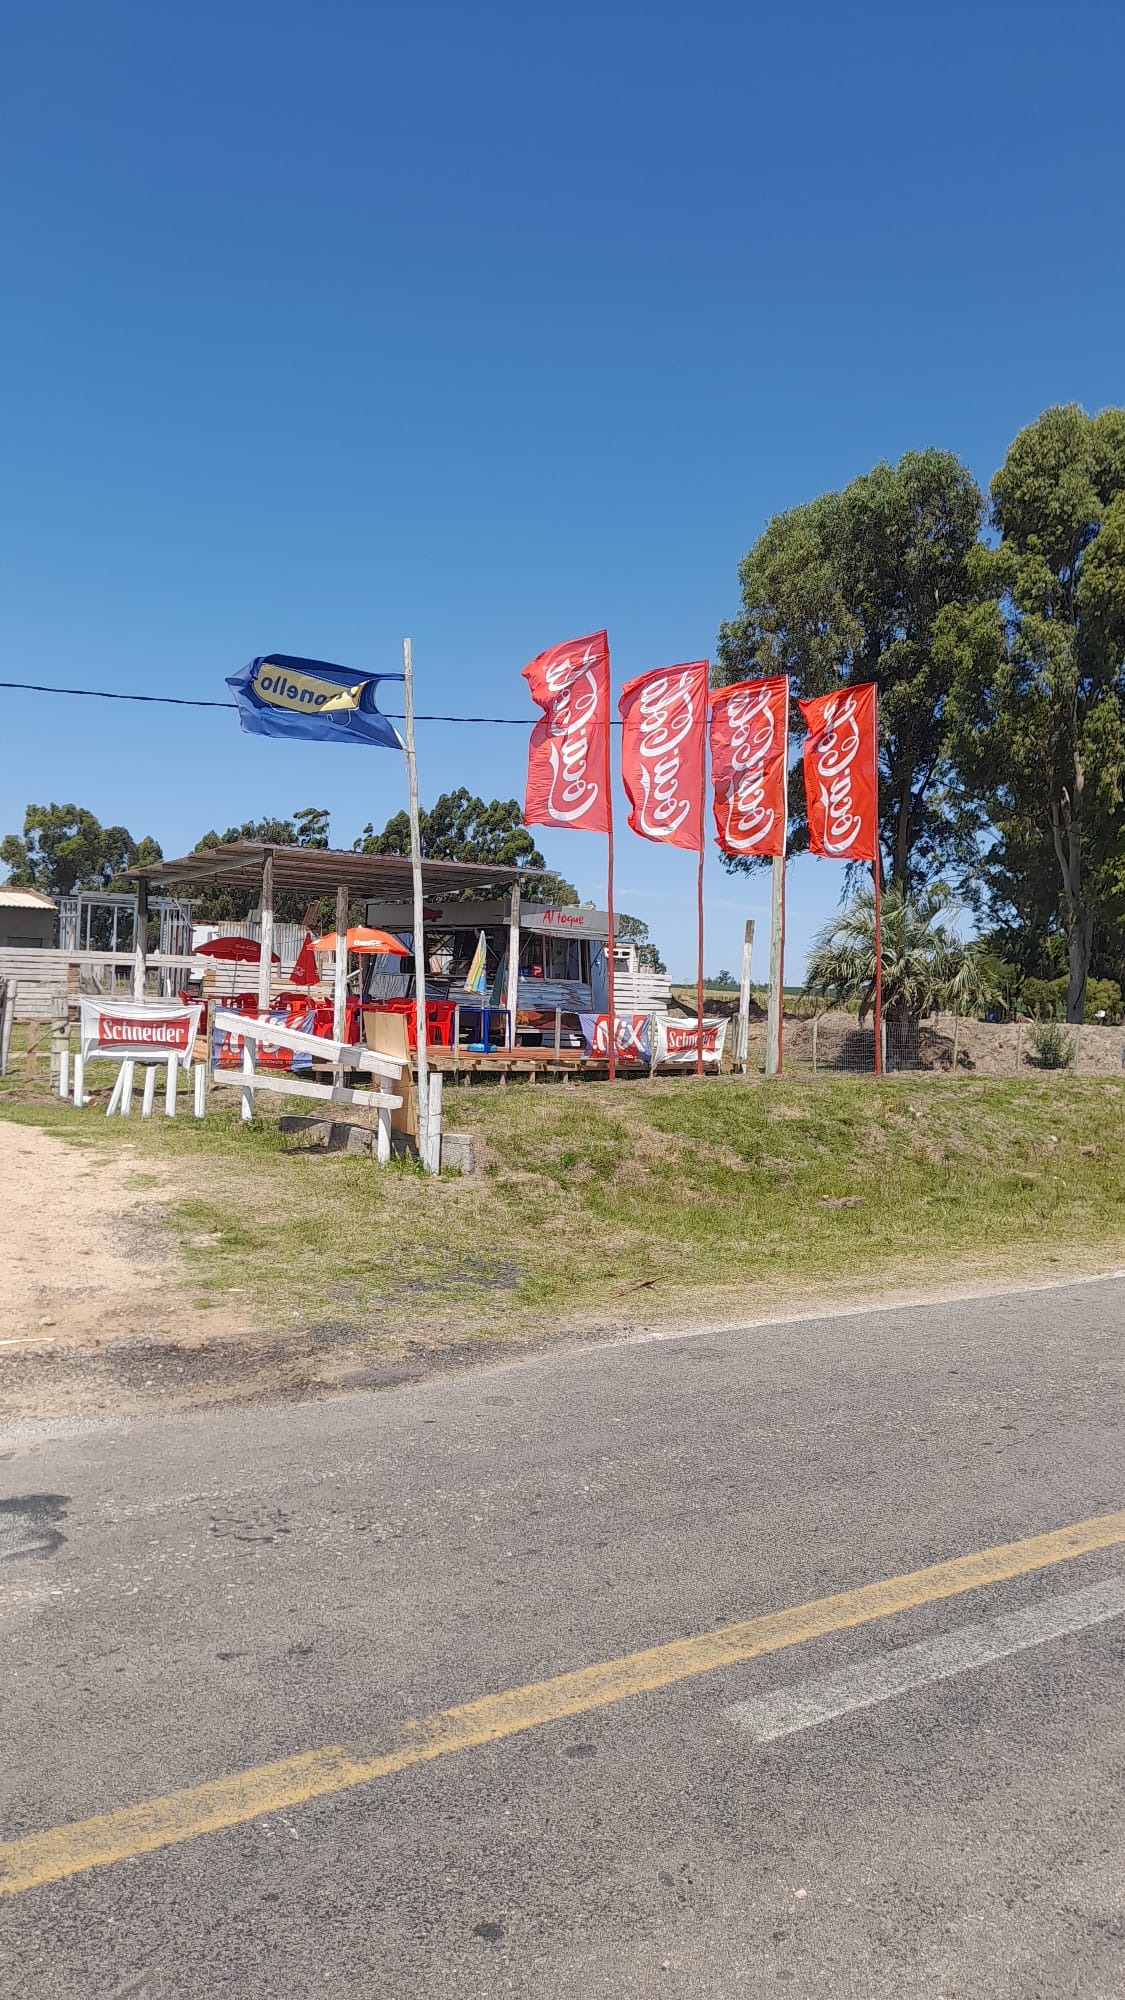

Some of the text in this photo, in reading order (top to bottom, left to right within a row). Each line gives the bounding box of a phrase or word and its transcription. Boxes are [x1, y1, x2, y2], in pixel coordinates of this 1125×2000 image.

[543, 909, 584, 928] Al toque
[103, 1019, 184, 1043] Schneider
